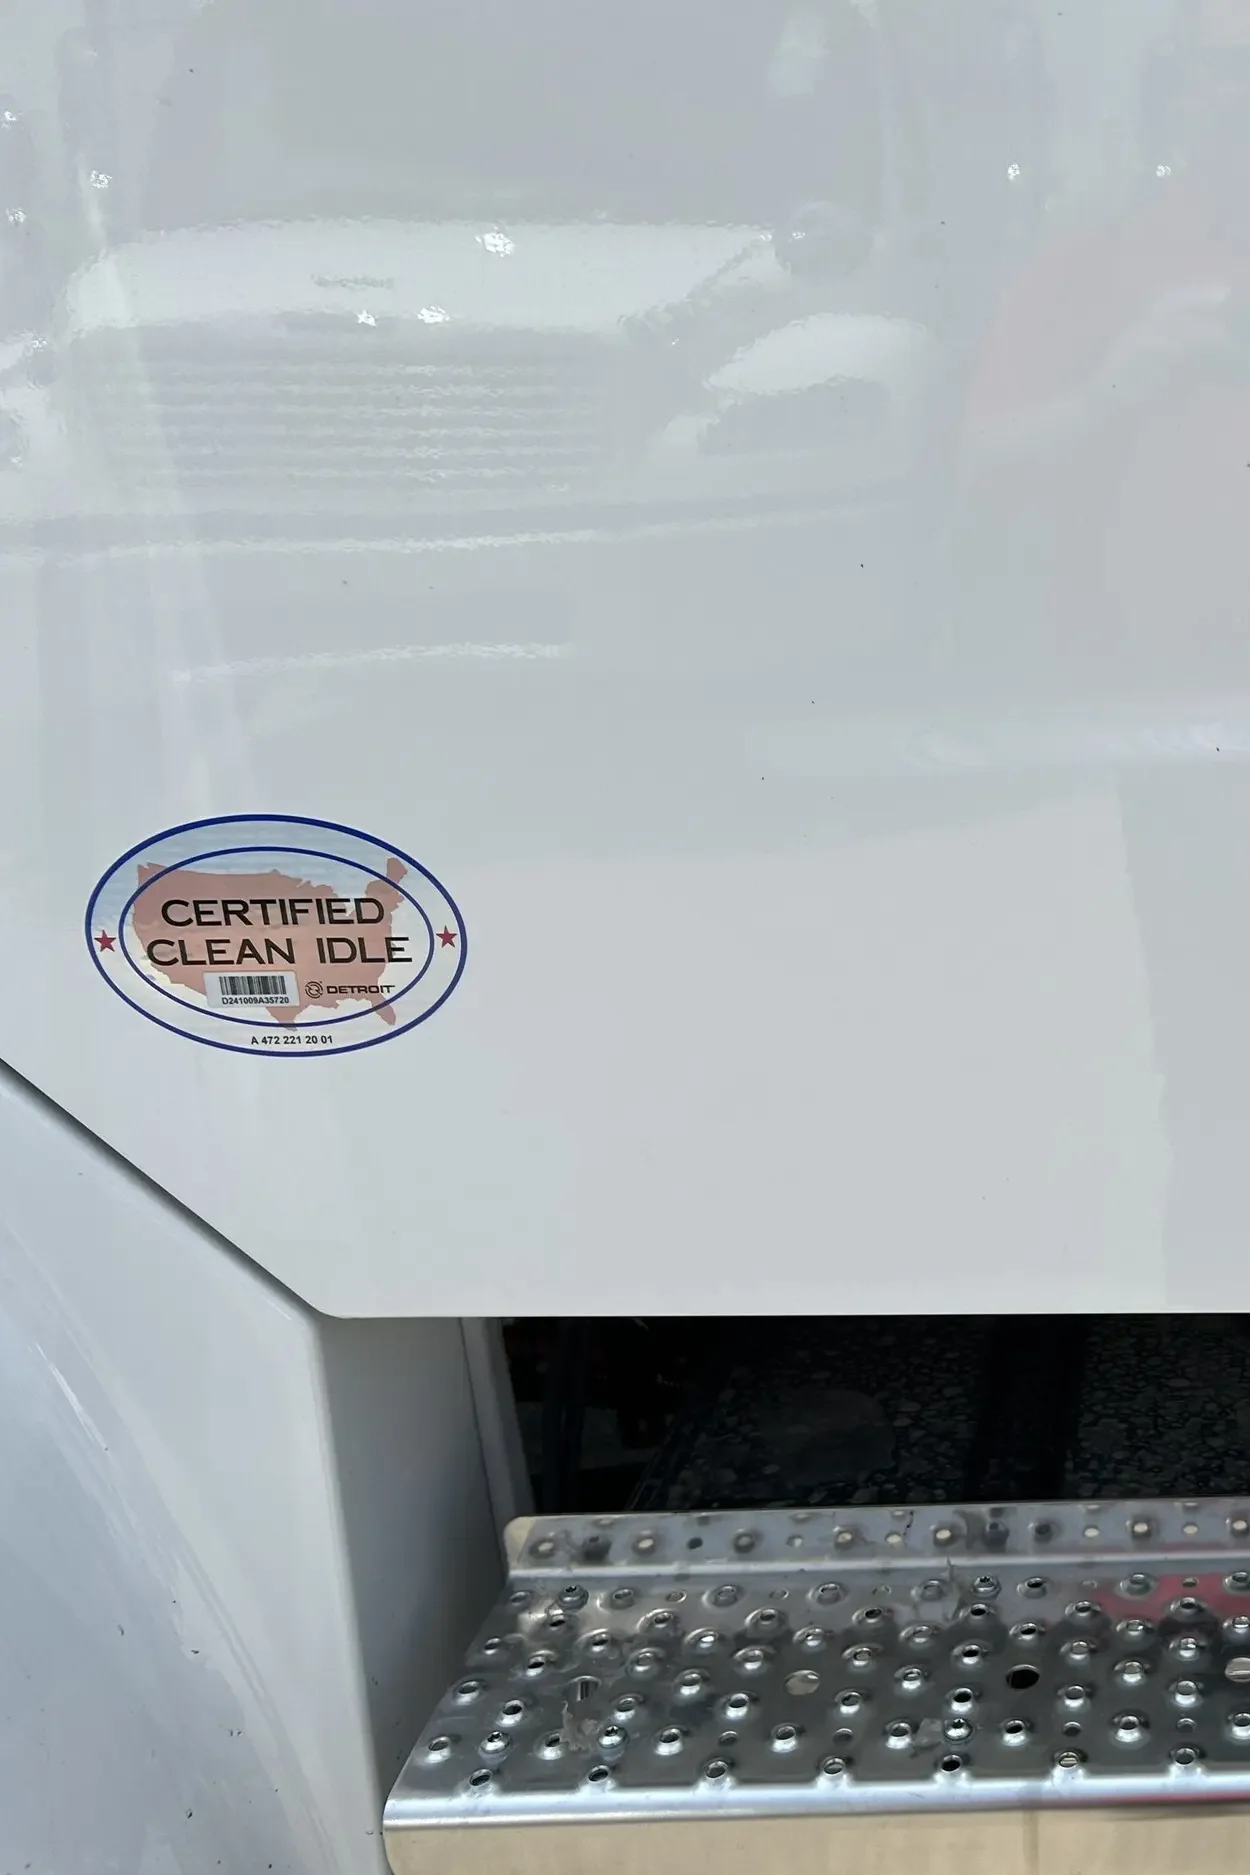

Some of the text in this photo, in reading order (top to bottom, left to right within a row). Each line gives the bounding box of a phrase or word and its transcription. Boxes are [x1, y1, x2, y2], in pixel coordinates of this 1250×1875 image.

[161, 897, 385, 927] CERTIFIED
[146, 936, 413, 967] CLEAN IDLE
[326, 984, 394, 995] DETROIT
[250, 1035, 333, 1046] A 472 221 20 01
